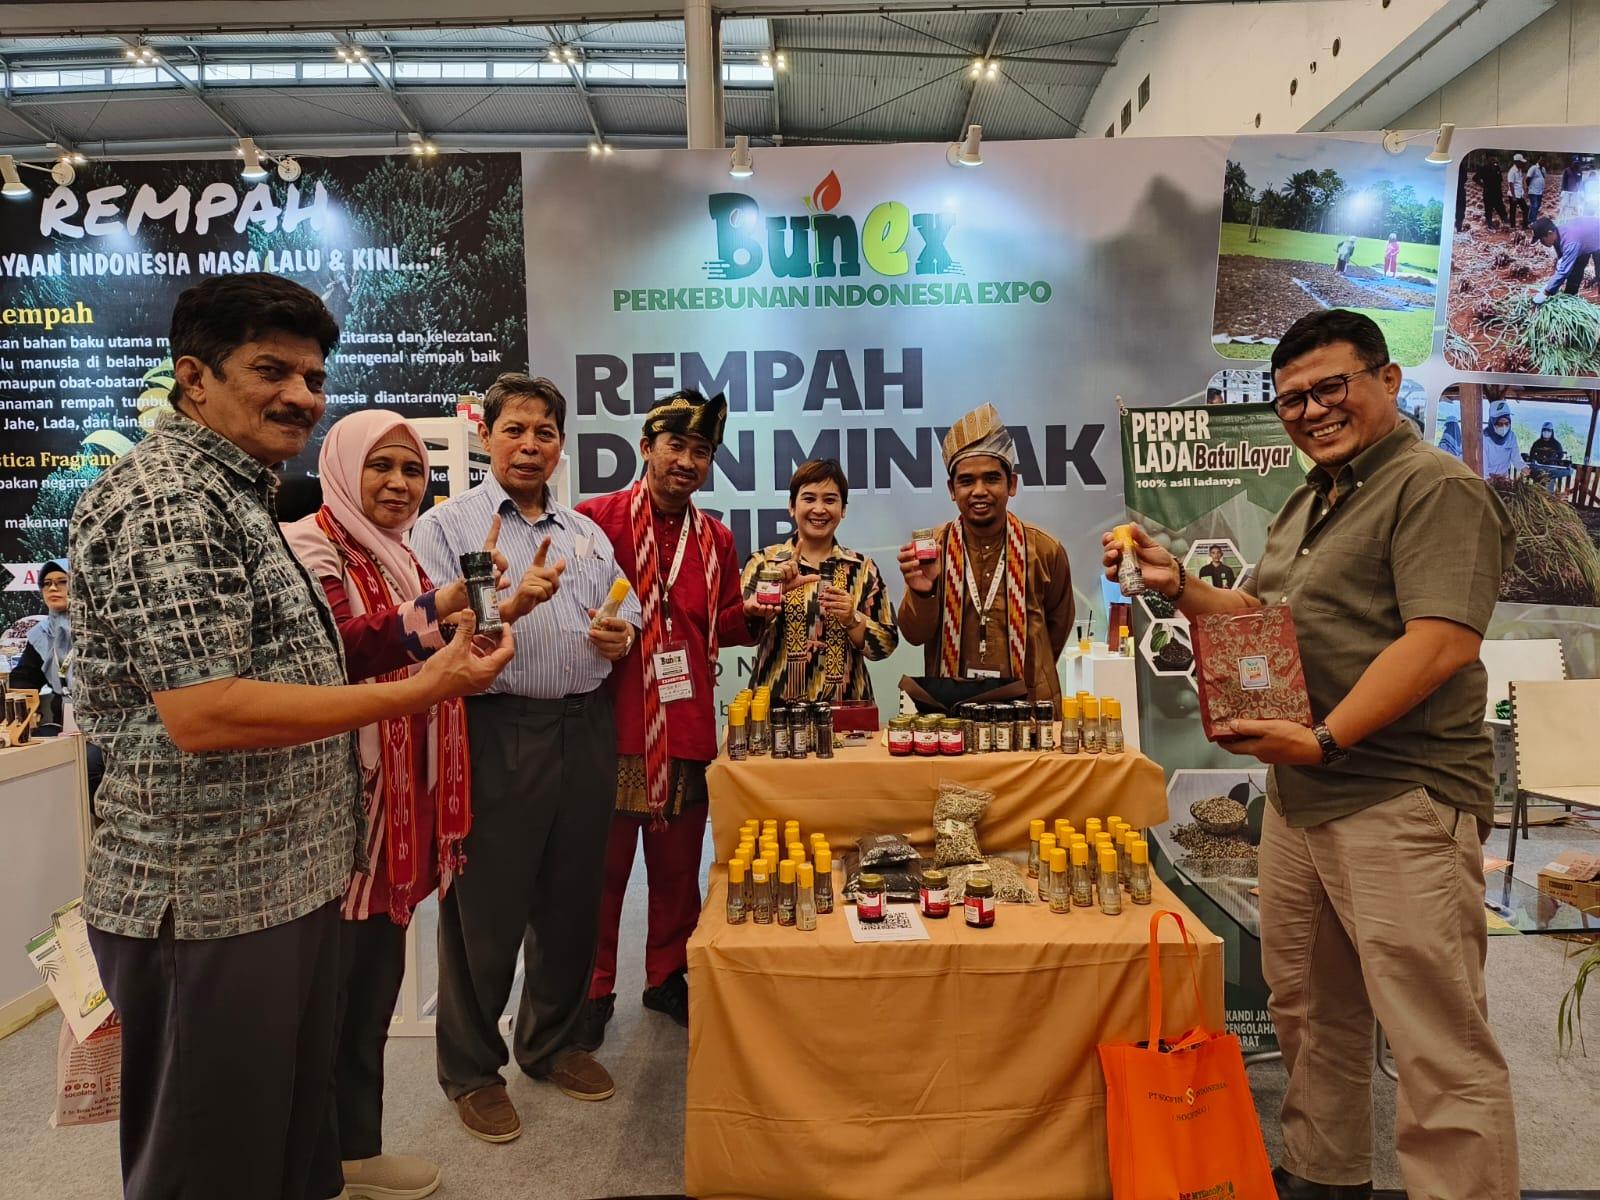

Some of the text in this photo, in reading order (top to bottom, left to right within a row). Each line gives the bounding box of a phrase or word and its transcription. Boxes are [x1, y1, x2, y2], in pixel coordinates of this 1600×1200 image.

[40, 180, 328, 238] REMPAH
[706, 192, 958, 280] Bunex
[0, 252, 62, 277] YAAN
[70, 251, 191, 276] INDONESIA
[199, 249, 260, 275] MASA
[267, 248, 321, 273] LALU
[329, 249, 345, 272] &
[613, 280, 1052, 312] PERKEBUNAN INDONESIA EXPO
[0, 301, 94, 330] empah
[23, 336, 67, 349] bahan
[70, 335, 104, 349] baku
[108, 336, 152, 348] utama
[340, 330, 497, 344] citarasa dan kelezatan.
[21, 356, 80, 369] manusia
[86, 356, 100, 368] di
[106, 356, 162, 368] belahan
[335, 351, 501, 367] mengenal rempah baik
[0, 376, 149, 393] maupun obat-obatan.
[576, 348, 923, 416] REMPAH
[61, 397, 115, 411] rempah
[325, 393, 367, 405] onesia
[4, 416, 155, 431] Jahe, Lada, dan lain-la
[1131, 409, 1211, 443] PEPPER
[41, 451, 120, 471] Fragranc
[578, 430, 756, 494] DN
[1133, 441, 1292, 475] LADA Batu Layar
[42, 480, 88, 491] negara
[1136, 477, 1241, 489] 100% asli ladanya
[5, 516, 68, 529] makanan
[1256, 1009, 1271, 1022] JAY
[1225, 1022, 1276, 1035] PENGOLAHA
[1239, 1035, 1260, 1047] ARAT
